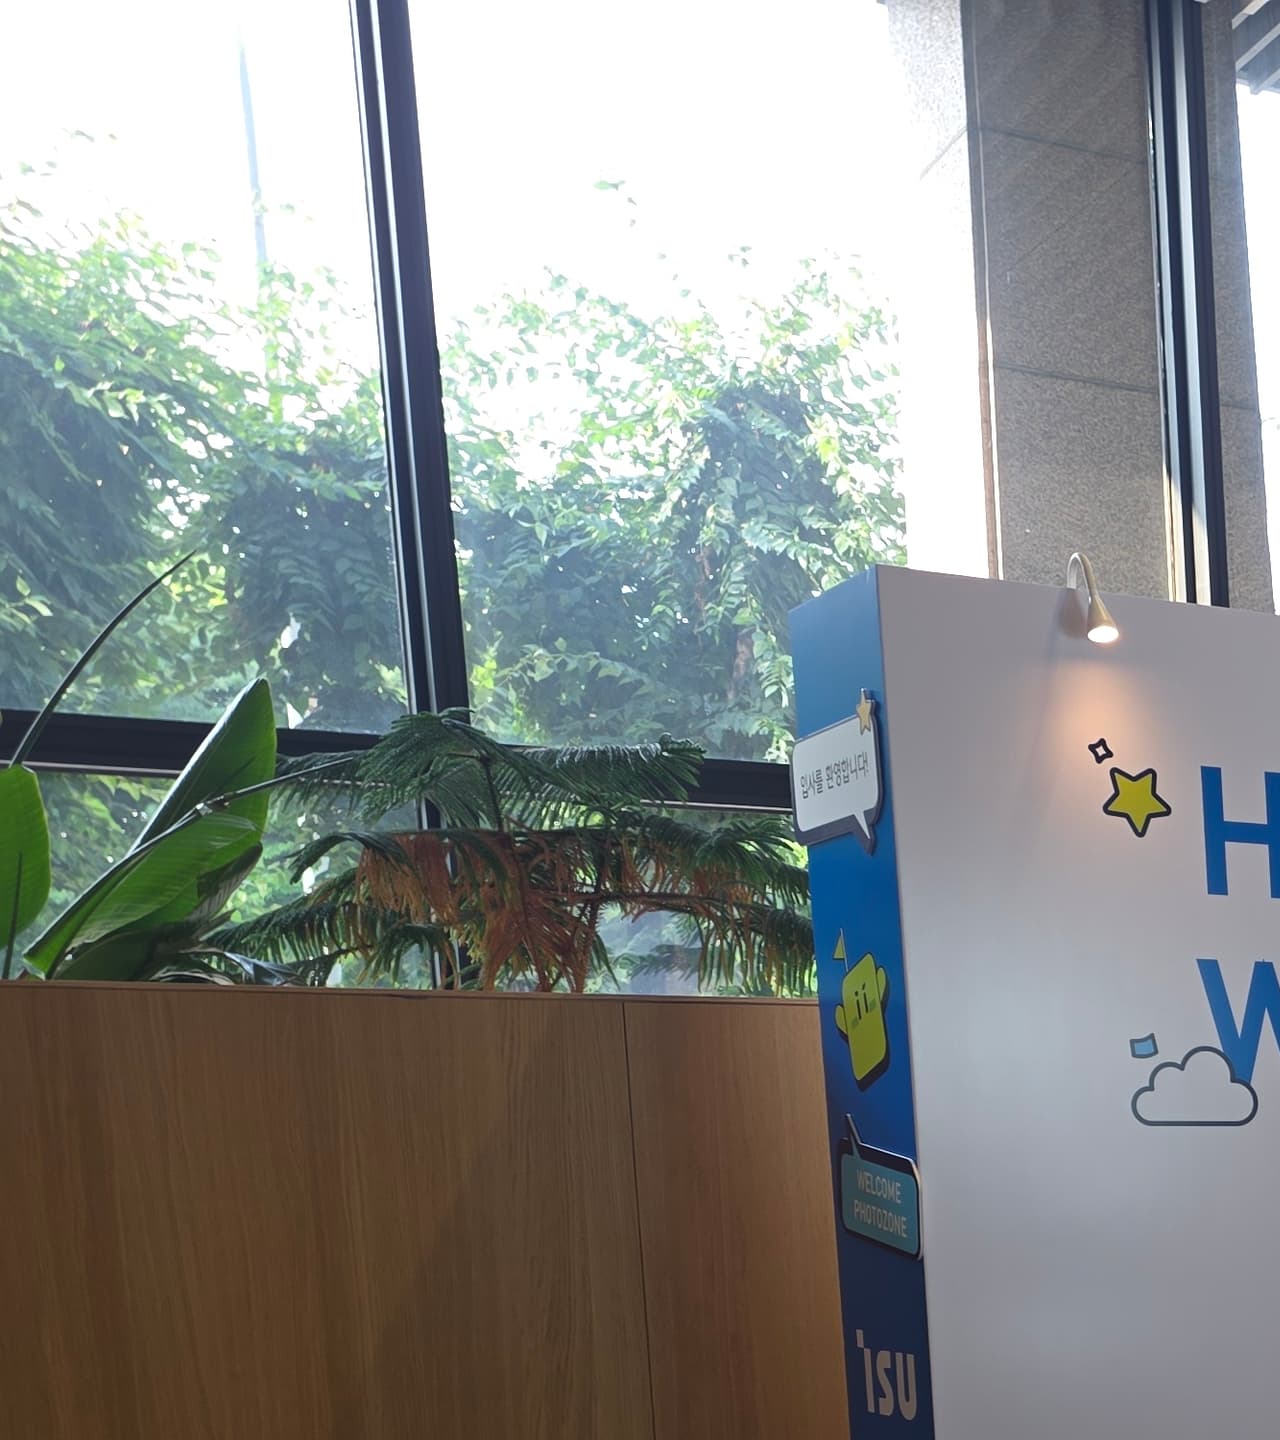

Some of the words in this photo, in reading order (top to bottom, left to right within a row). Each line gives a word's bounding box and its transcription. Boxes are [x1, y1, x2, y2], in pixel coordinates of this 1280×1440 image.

[800, 768, 824, 800] 입사를
[825, 751, 870, 790] 환영합니다!
[856, 1168, 903, 1205] WELCOME
[853, 1199, 908, 1239] PHOTOZONE
